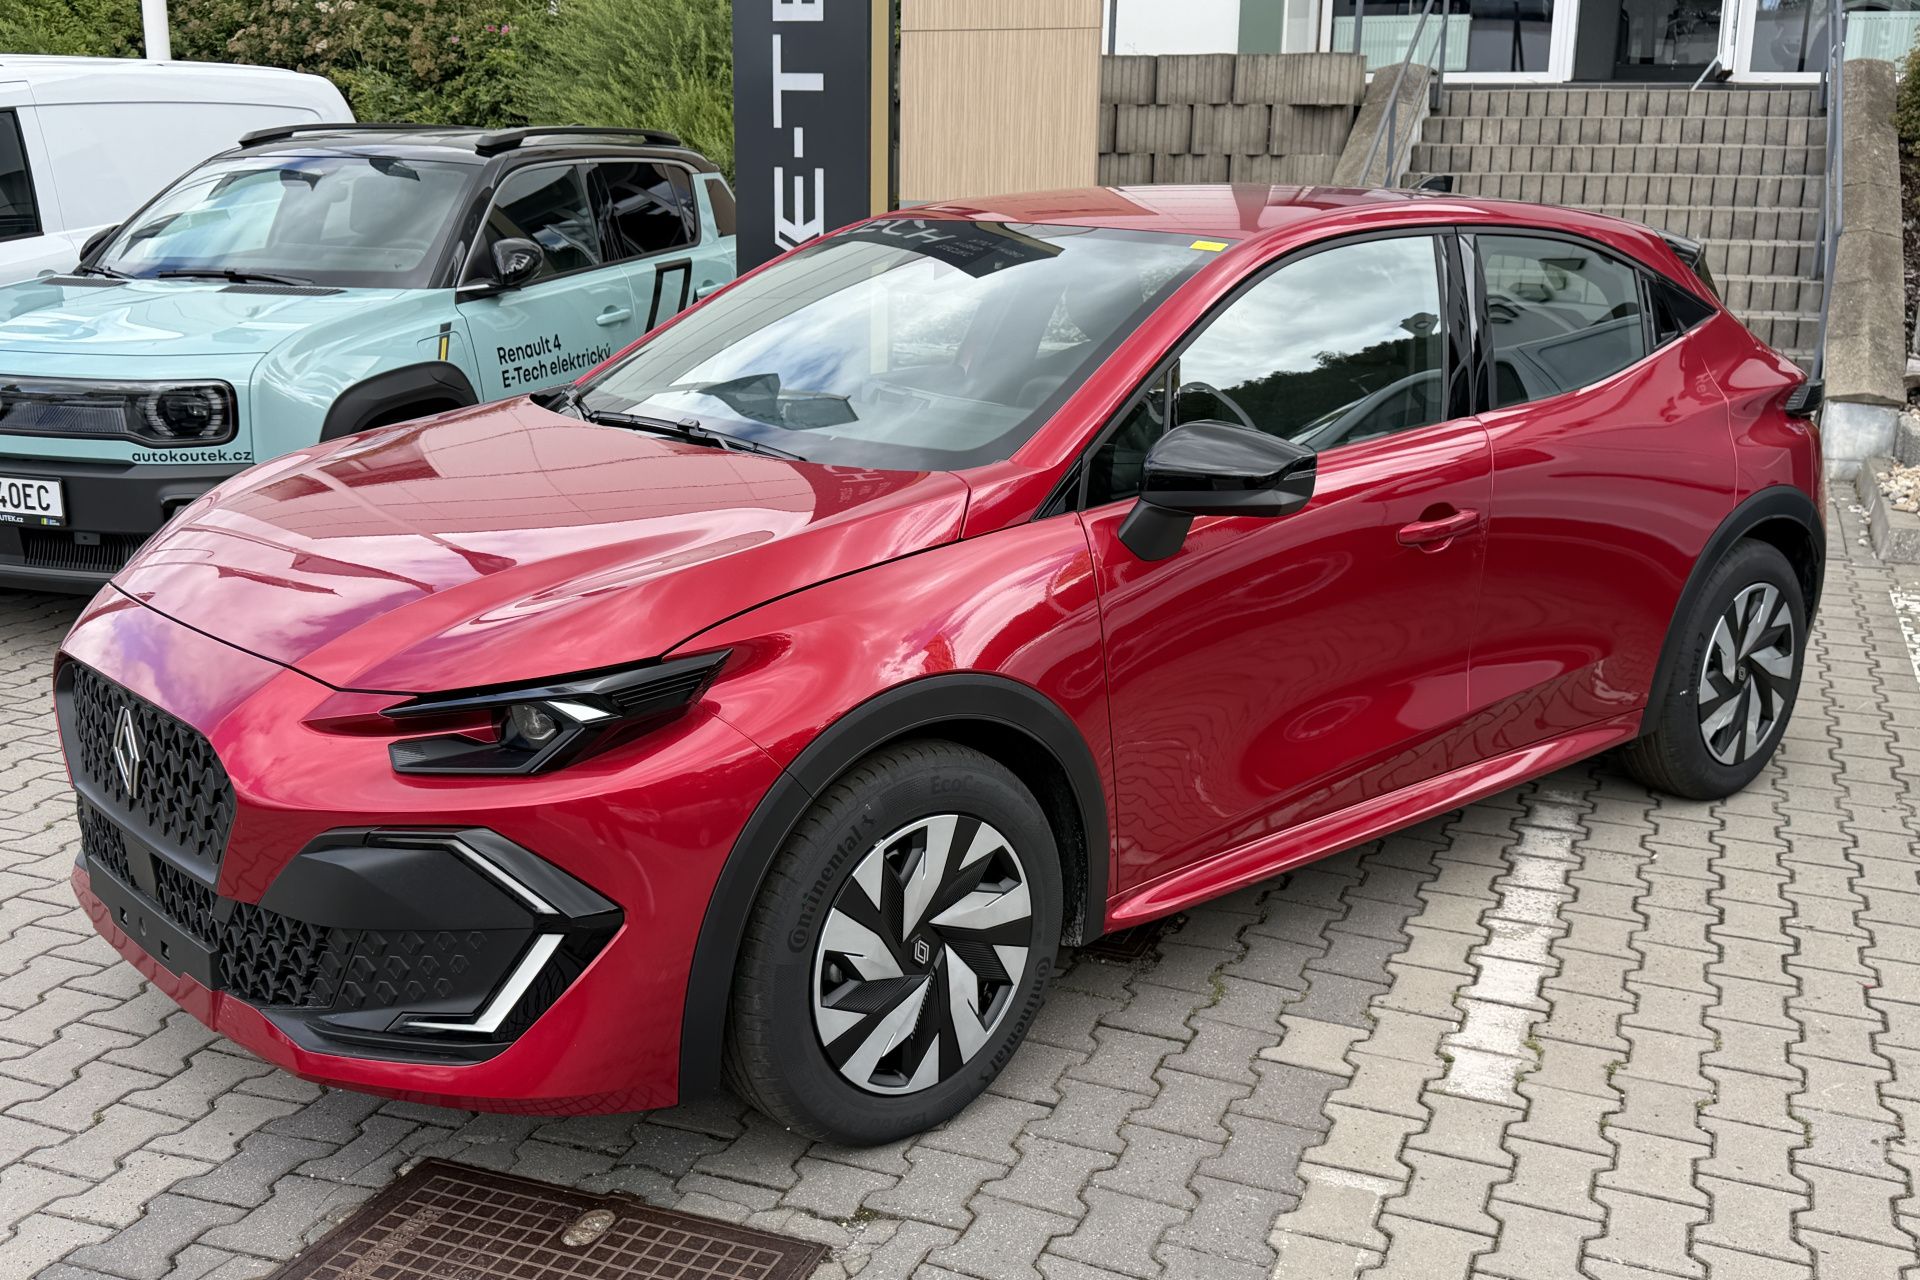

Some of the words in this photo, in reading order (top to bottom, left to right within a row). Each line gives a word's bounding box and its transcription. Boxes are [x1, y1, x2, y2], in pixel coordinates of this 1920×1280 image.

[497, 336, 552, 365] Renault
[553, 334, 562, 351] 4
[502, 360, 548, 388] E-Tech
[550, 343, 611, 375] elektrický
[132, 450, 252, 462] autokoutek.cz
[788, 824, 863, 953] Continental
[989, 956, 1052, 1072] Continental
